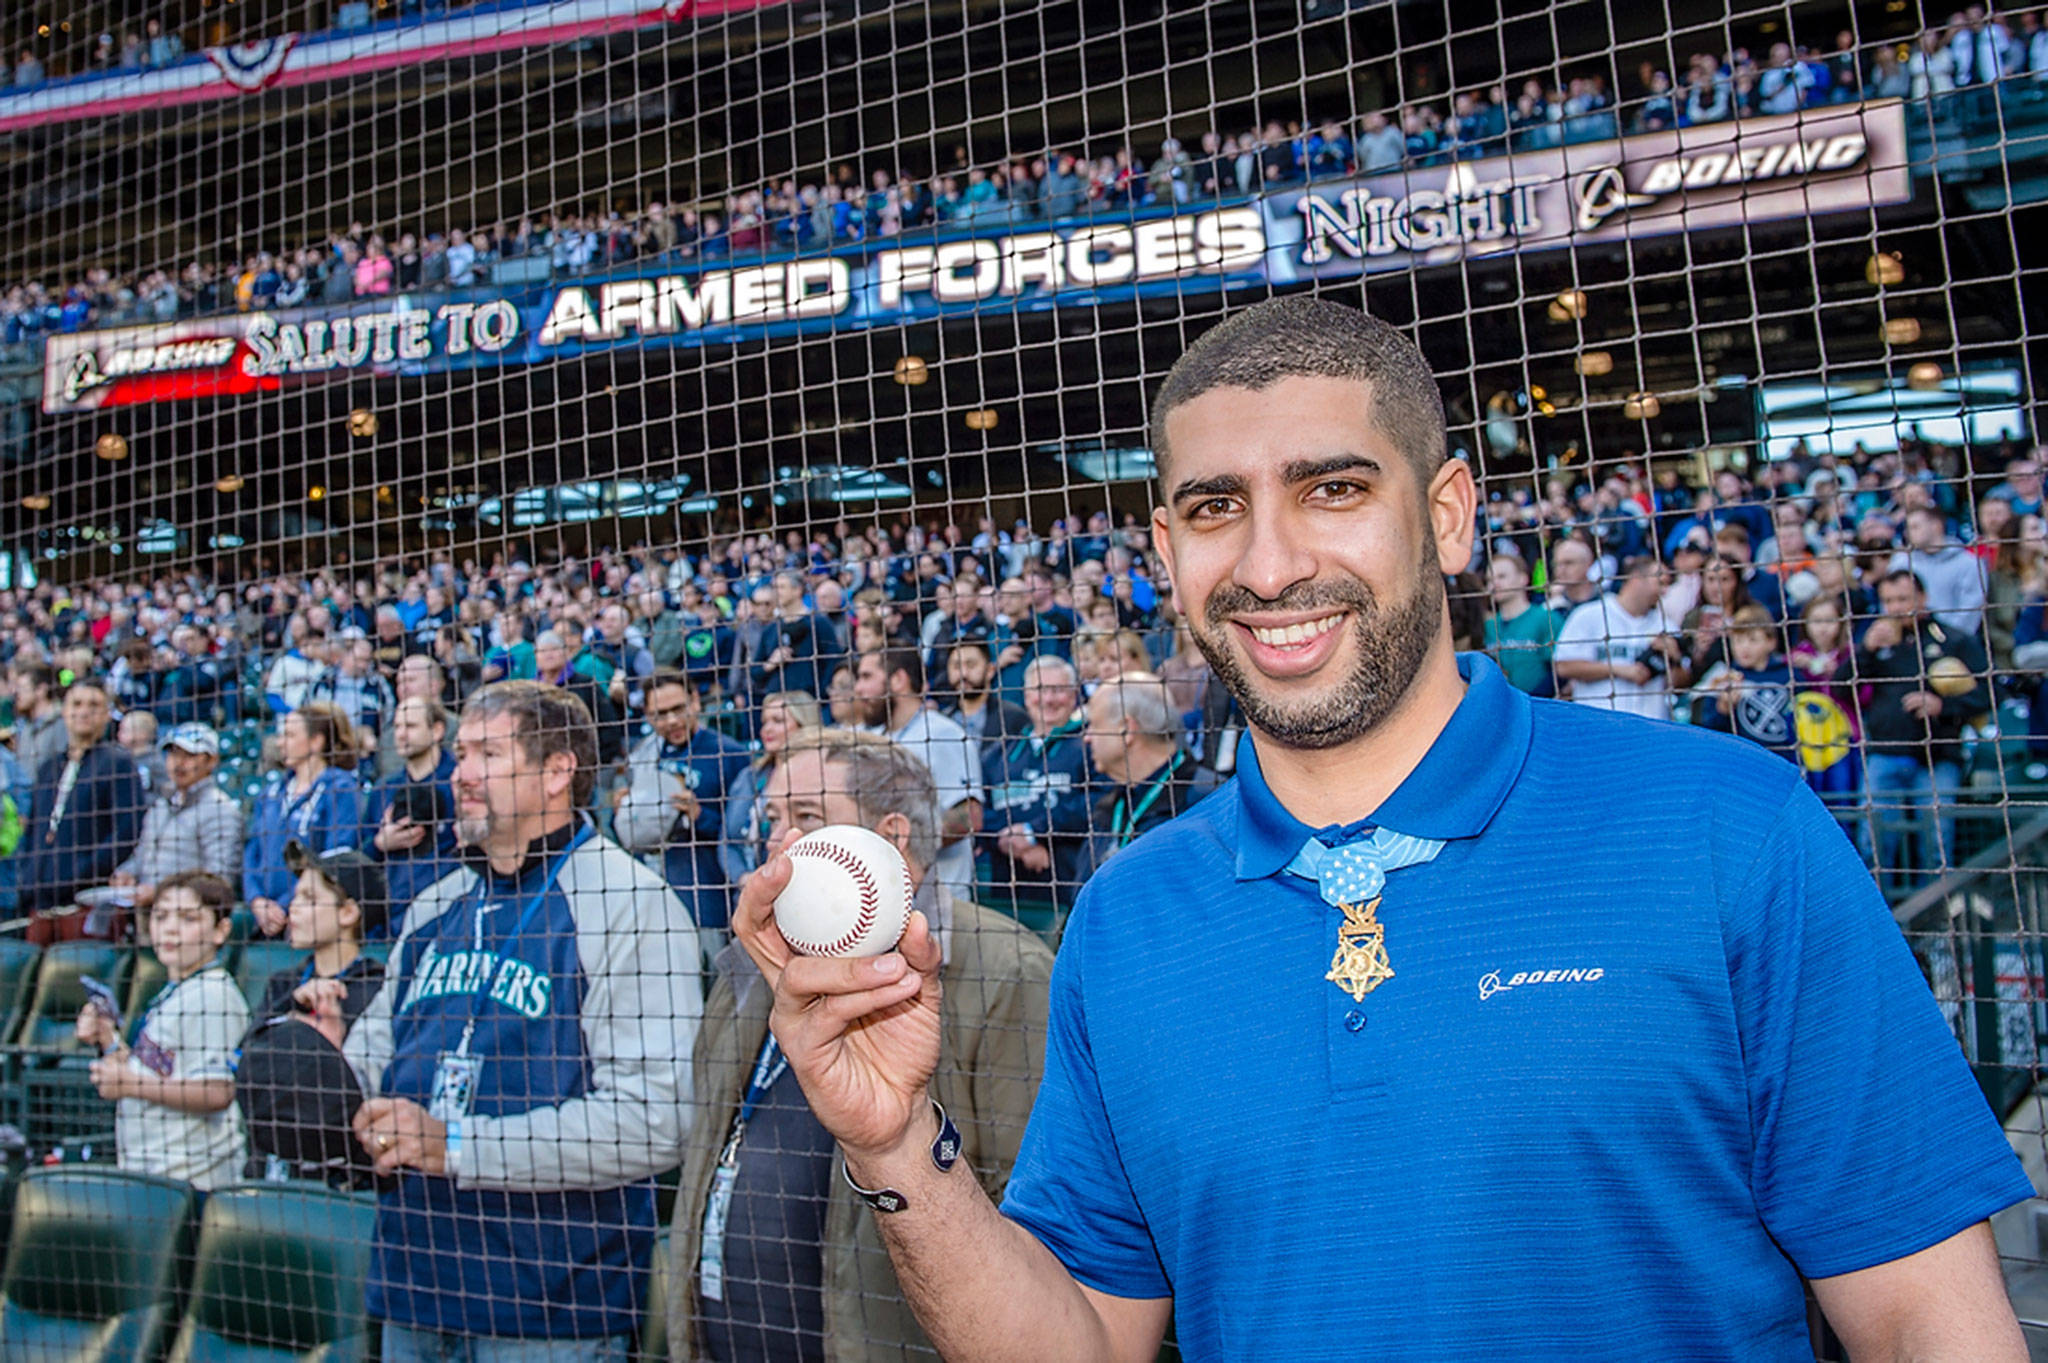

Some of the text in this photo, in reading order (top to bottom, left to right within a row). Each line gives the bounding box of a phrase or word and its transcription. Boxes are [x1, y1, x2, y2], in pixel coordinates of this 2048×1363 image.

[1641, 132, 1867, 194] BOEING
[242, 174, 1552, 377] SALUTE TO ARMED FORCES NIGHT
[1508, 968, 1604, 986] BOEING
